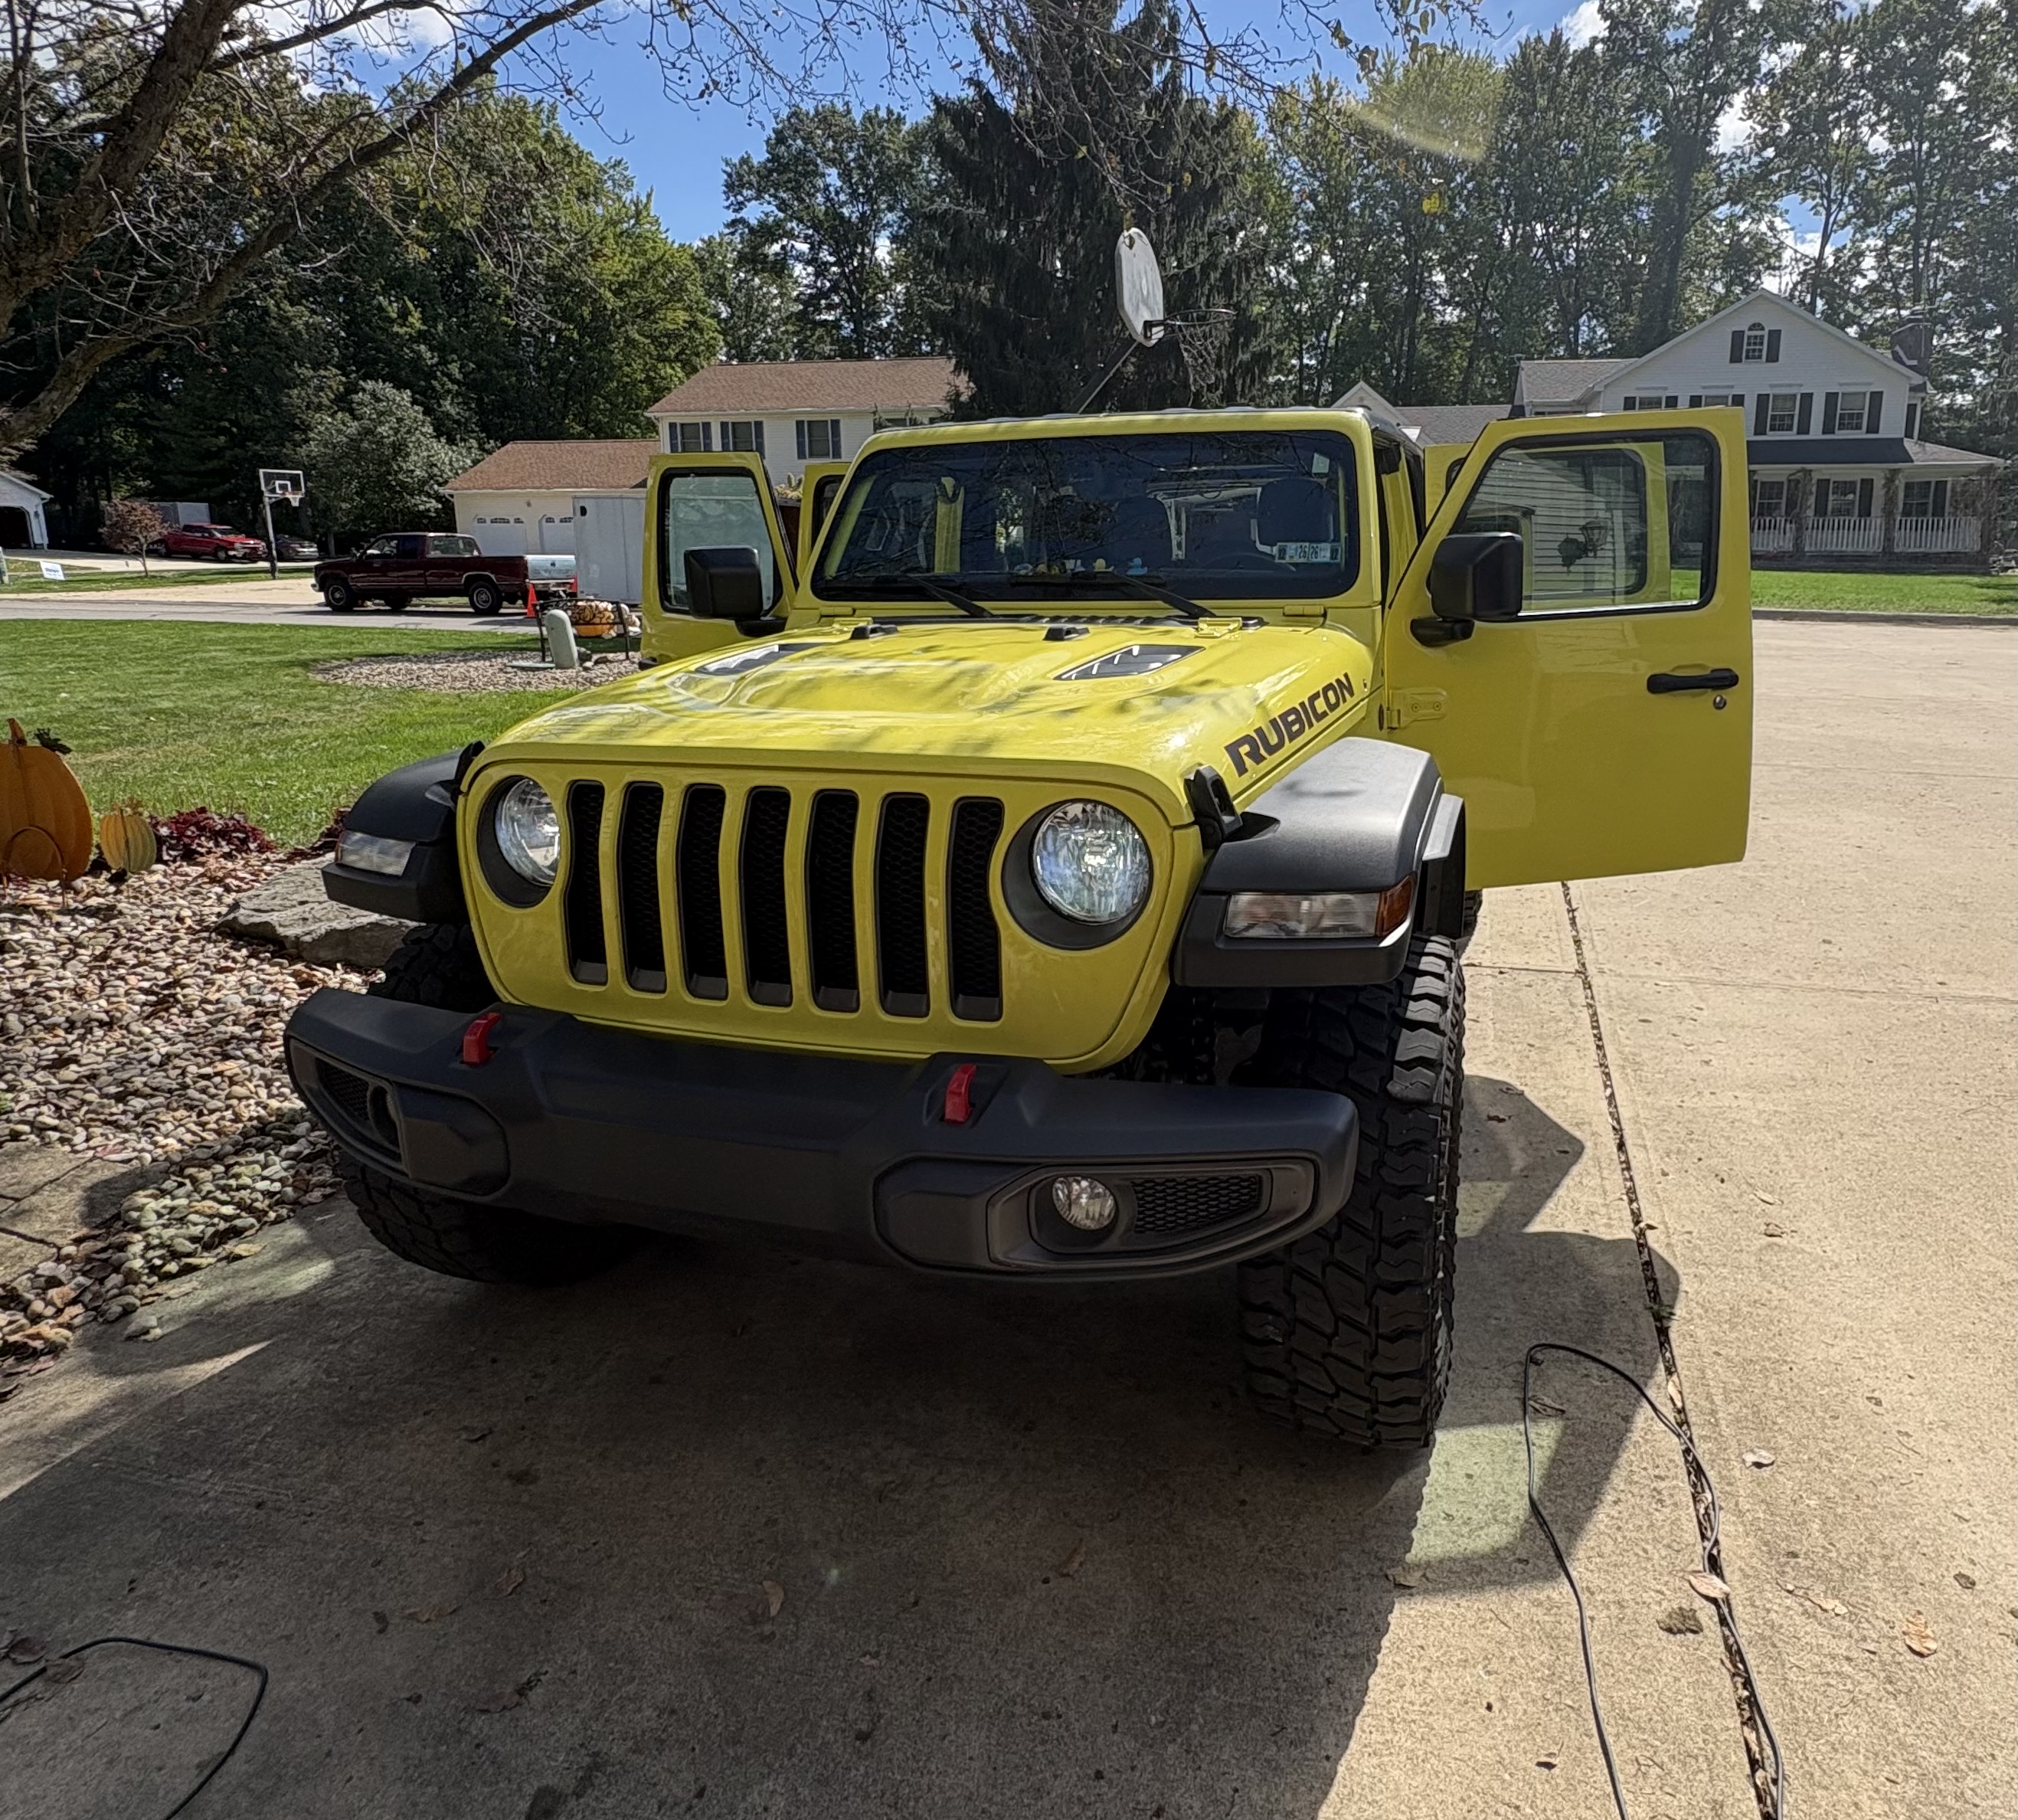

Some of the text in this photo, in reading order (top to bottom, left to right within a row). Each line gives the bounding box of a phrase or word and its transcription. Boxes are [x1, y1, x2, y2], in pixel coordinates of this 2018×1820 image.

[1298, 545, 1307, 559] 26
[1310, 545, 1319, 559] 26
[1224, 672, 1355, 778] RUBICON
